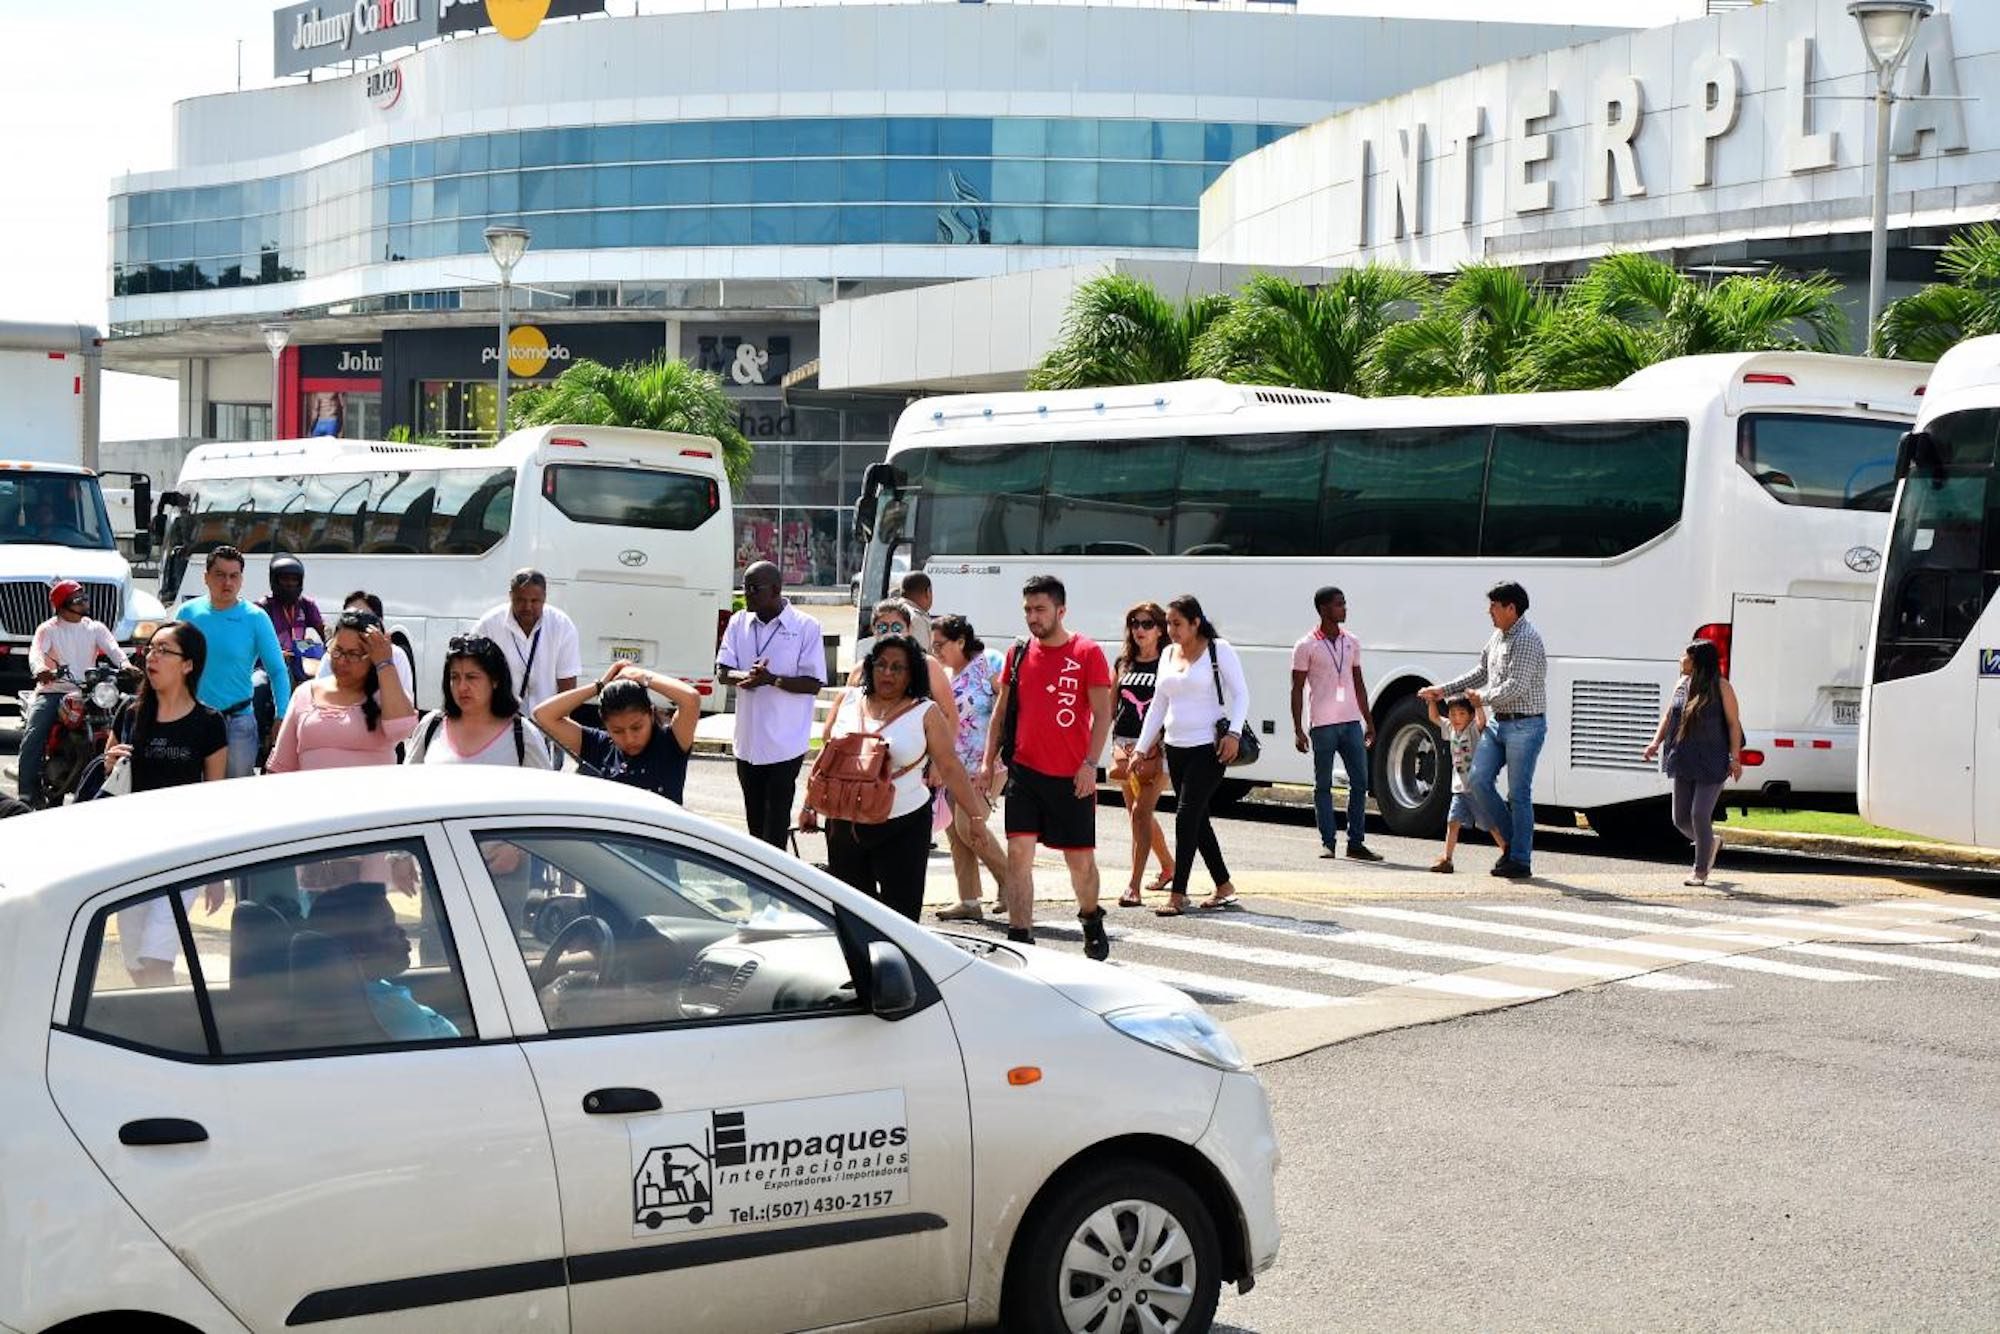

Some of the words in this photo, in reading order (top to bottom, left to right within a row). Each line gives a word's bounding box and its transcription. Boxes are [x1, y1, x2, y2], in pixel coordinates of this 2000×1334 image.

[292, 8, 352, 50] Johnny
[1358, 13, 1970, 247] INTERPLA
[482, 344, 570, 364] putomoda
[1056, 656, 1081, 728] AERO
[711, 1111, 907, 1168] Empaques
[719, 1152, 908, 1185] Internacionales
[764, 1173, 832, 1191] Exportadores
[842, 1165, 908, 1182] Importadores
[813, 1190, 893, 1213] 430-2157
